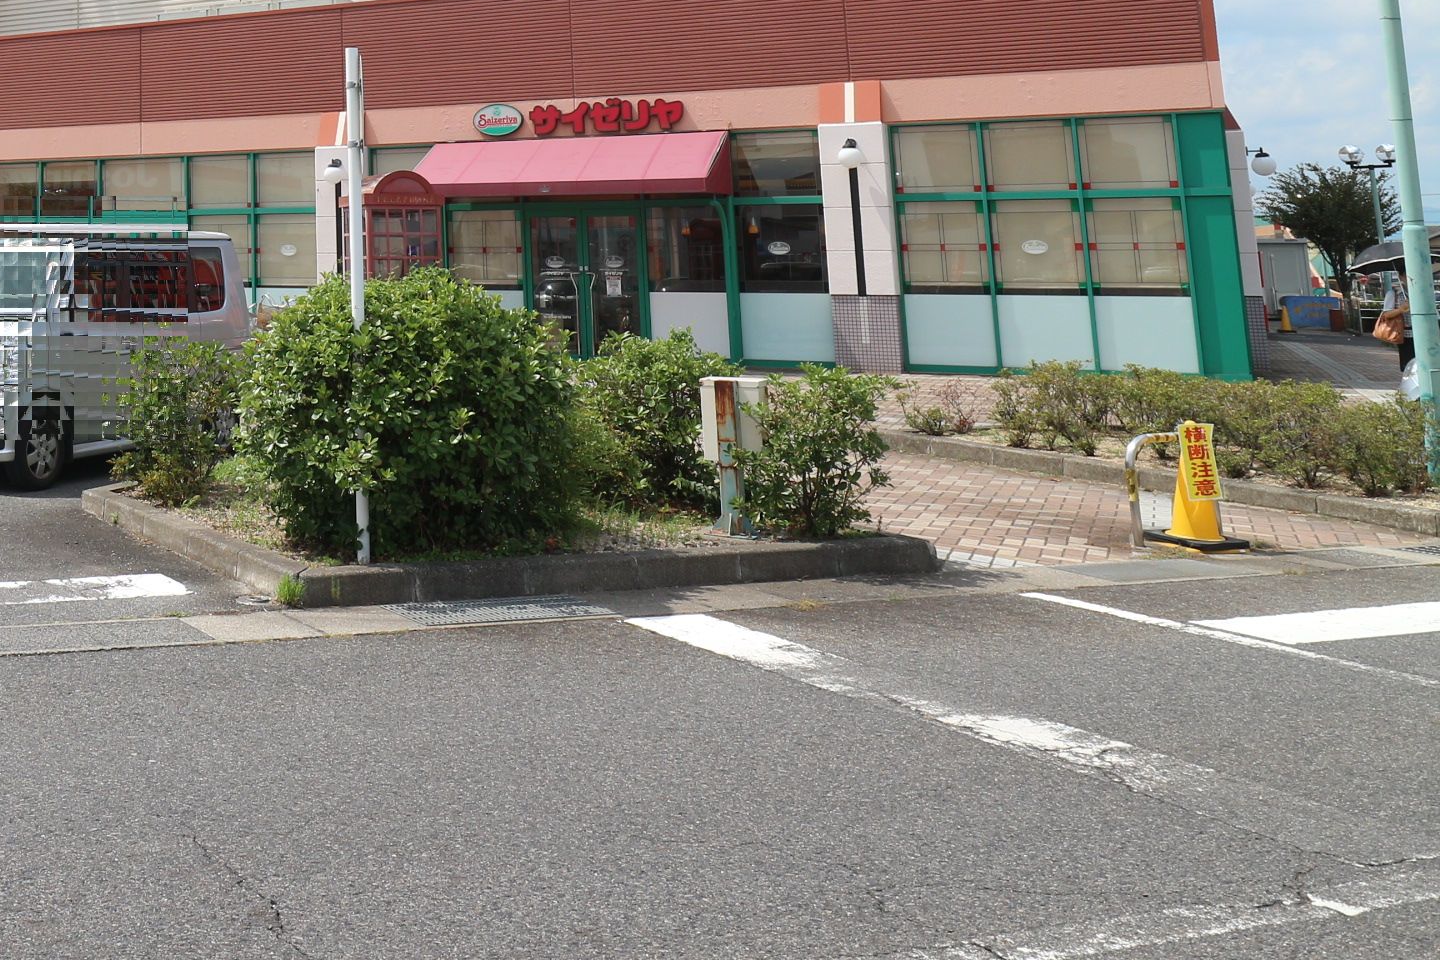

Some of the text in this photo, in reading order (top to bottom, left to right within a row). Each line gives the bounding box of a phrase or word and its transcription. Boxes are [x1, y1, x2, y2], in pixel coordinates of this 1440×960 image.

[528, 97, 685, 136] サイゼリヤ
[1184, 426, 1218, 496] 横断注意
